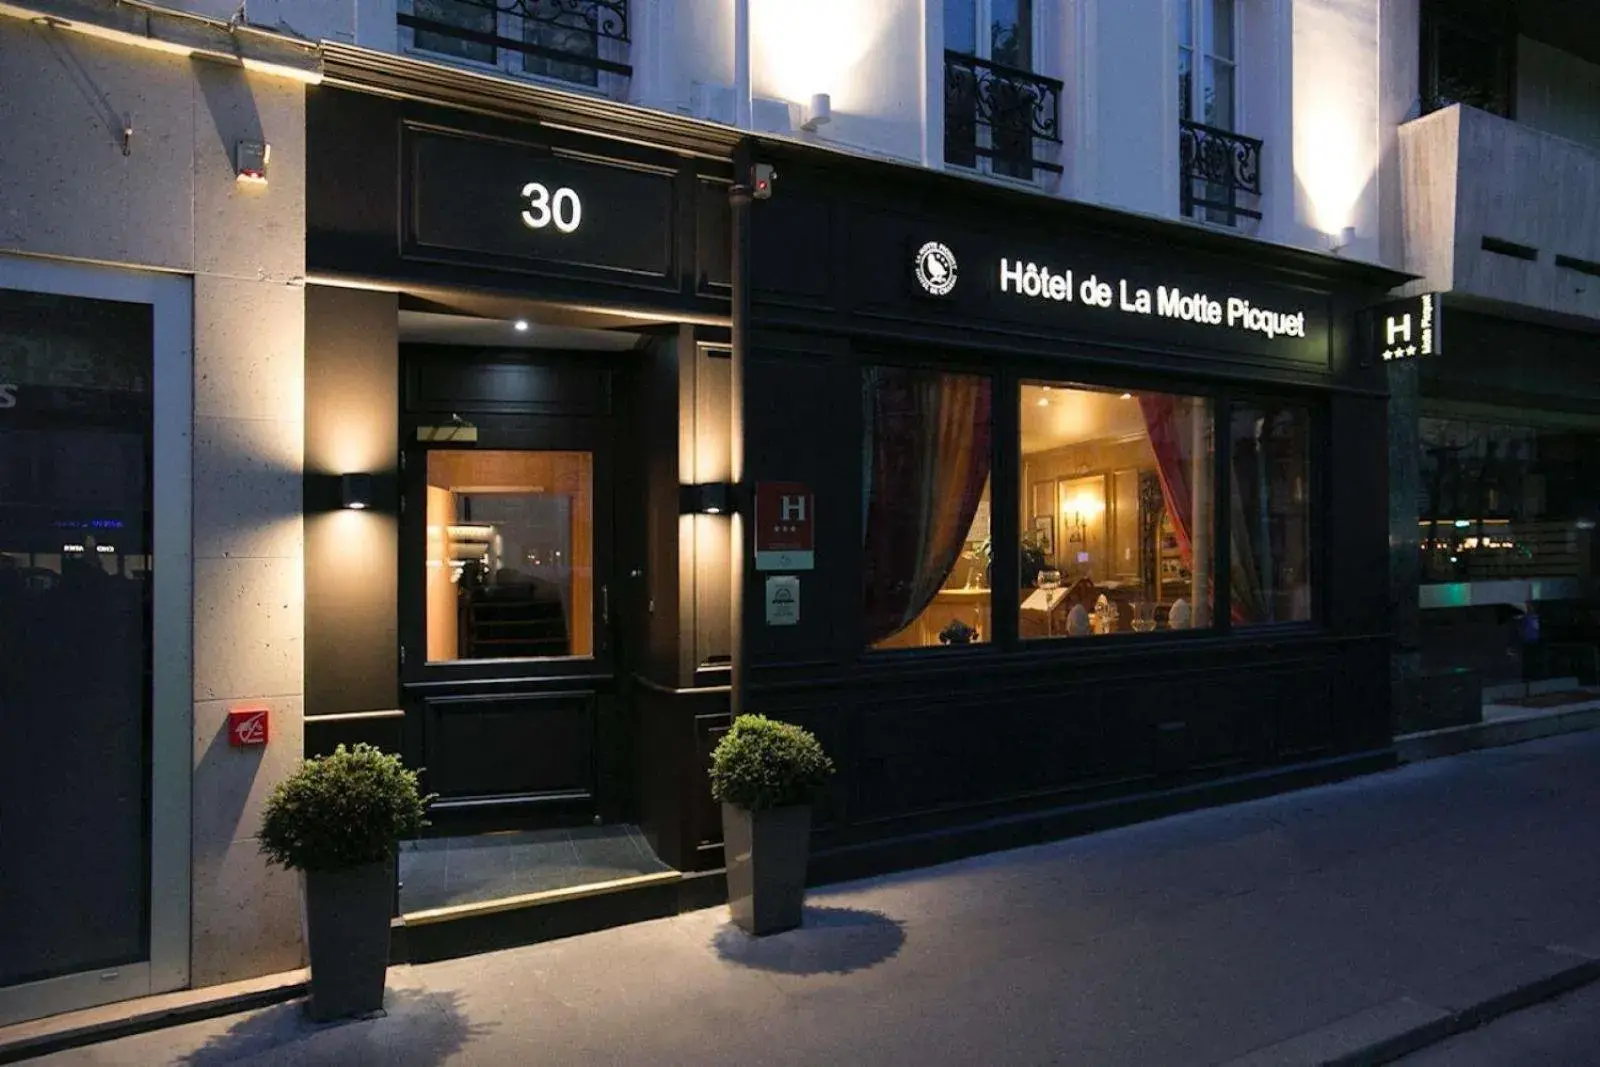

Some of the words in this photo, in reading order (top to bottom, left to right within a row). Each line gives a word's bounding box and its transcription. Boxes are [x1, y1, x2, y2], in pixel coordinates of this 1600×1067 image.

[521, 182, 582, 233] 30
[1000, 257, 1073, 302] Hôtel
[1079, 274, 1113, 308] de
[1119, 278, 1152, 314] La
[1156, 285, 1223, 325] Motte
[1226, 296, 1306, 339] Picquet
[1385, 312, 1412, 346] H
[781, 494, 807, 522] H
